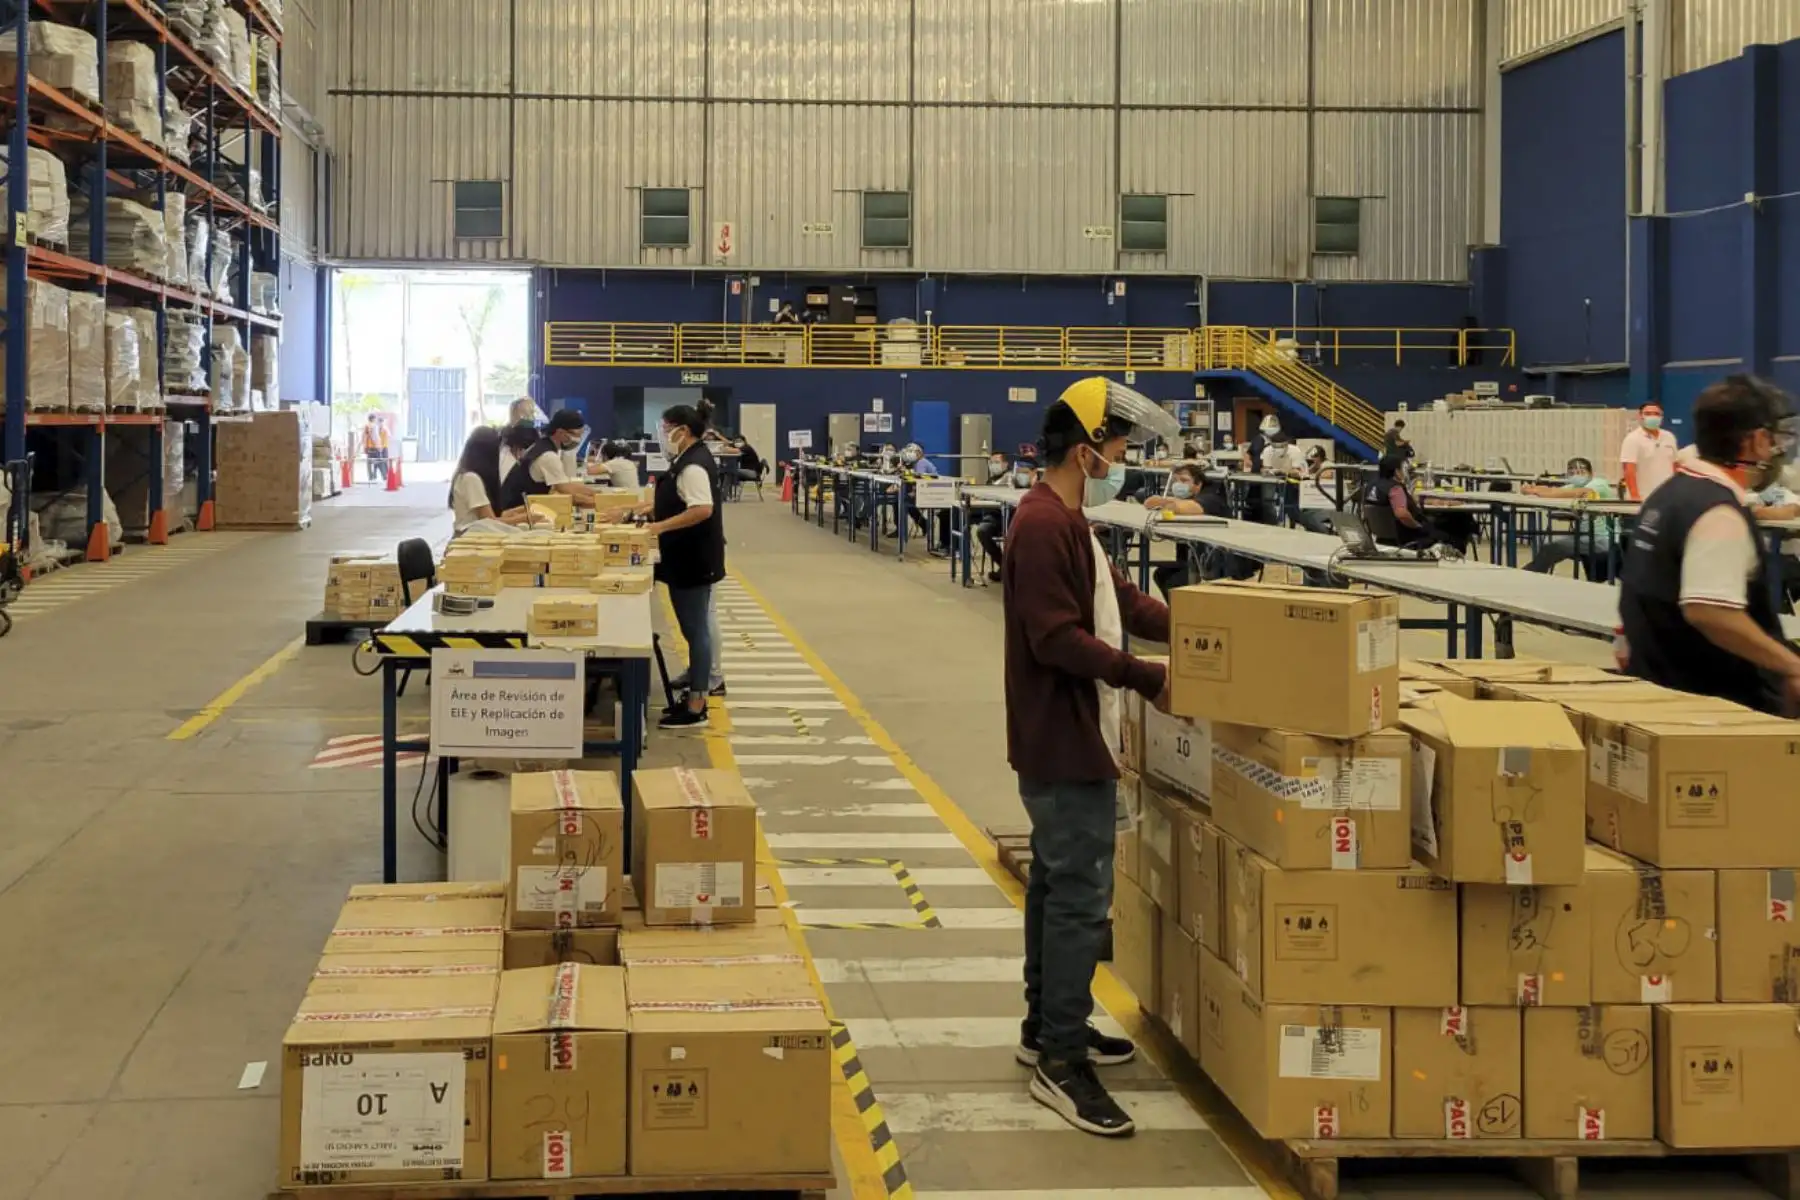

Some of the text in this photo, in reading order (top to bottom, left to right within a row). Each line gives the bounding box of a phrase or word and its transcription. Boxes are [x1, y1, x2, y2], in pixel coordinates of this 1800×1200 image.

[450, 686, 565, 702] Área de Revisión de
[450, 708, 565, 722] EIE y Replicación de
[485, 725, 529, 739] Imagen
[1176, 736, 1190, 758] 10
[429, 1081, 449, 1105] A
[356, 1093, 388, 1117] 10
